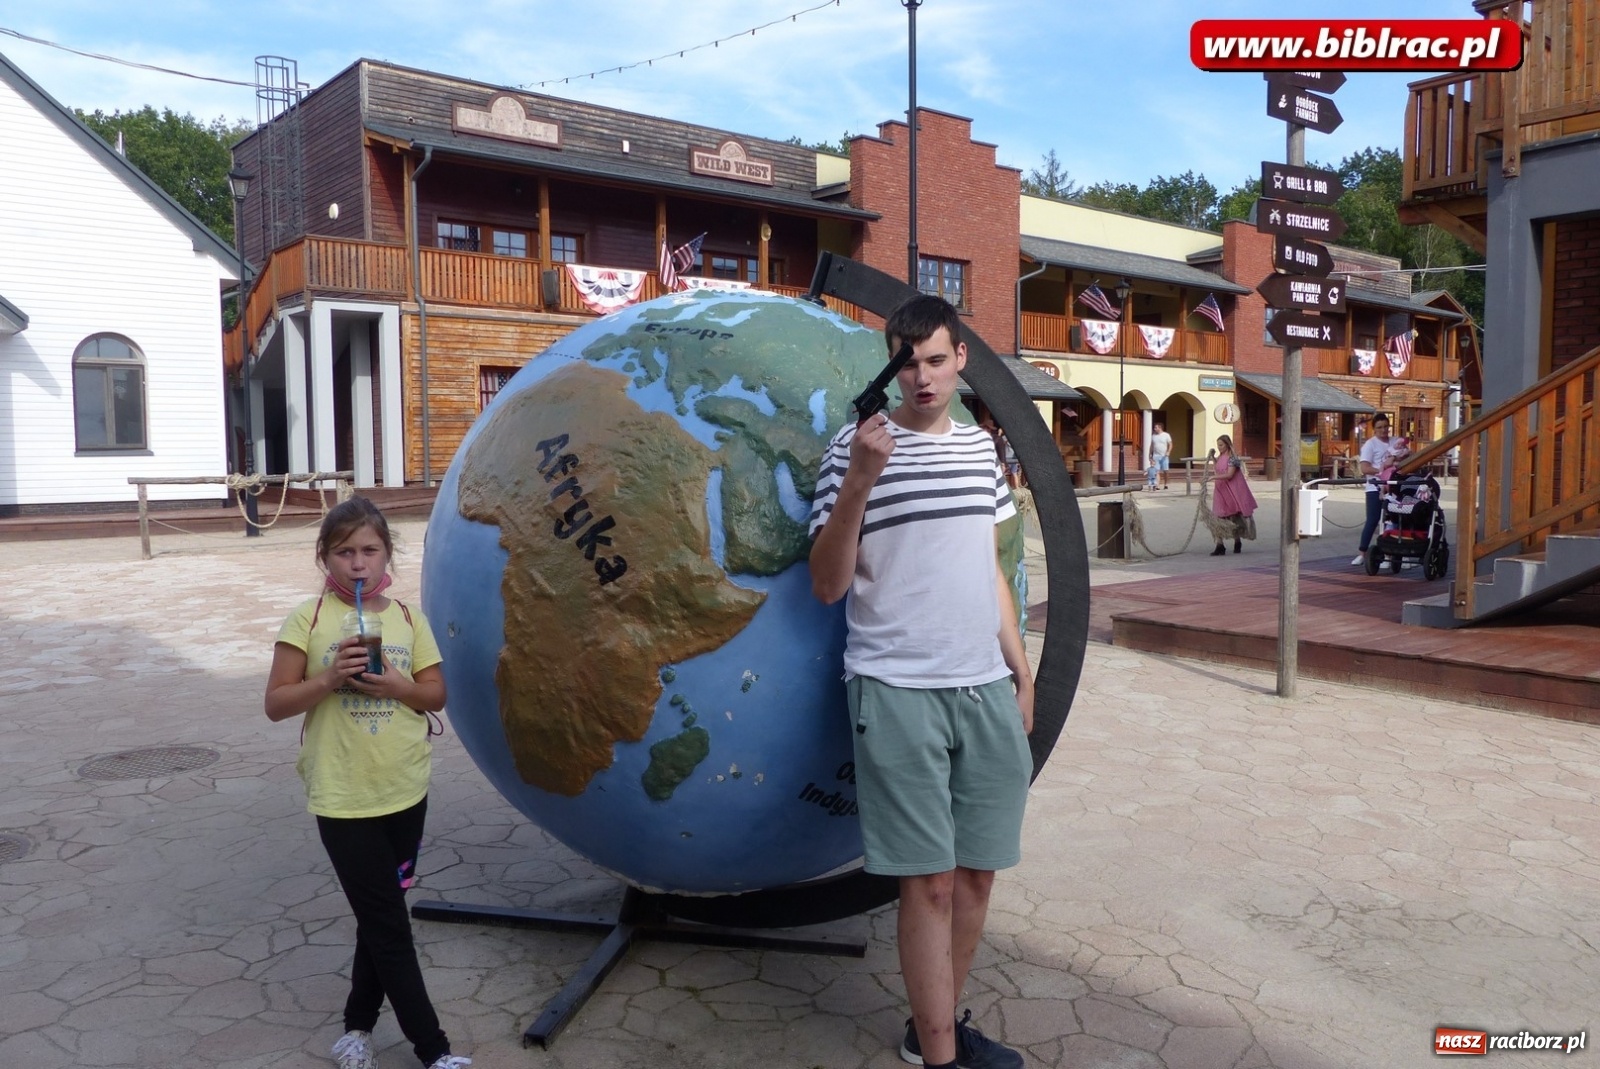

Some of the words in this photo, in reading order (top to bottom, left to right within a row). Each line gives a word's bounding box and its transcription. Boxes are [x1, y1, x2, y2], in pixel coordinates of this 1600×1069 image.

[1295, 96, 1319, 112] OGRÓDEK
[1295, 107, 1319, 123] FARMERA
[696, 155, 731, 172] WILD
[734, 161, 769, 179] WEST
[1286, 176, 1305, 191] GRILL
[1306, 179, 1312, 191] &
[1314, 180, 1328, 194] BBQ
[1286, 213, 1330, 231] STRZELNICE
[1295, 249, 1305, 262] OLD
[1305, 253, 1318, 267] FOTO
[1290, 281, 1321, 294] KAWIARNIA
[1292, 292, 1304, 303] PAN
[1305, 294, 1319, 304] CAKE
[1286, 324, 1319, 339] RESTAURACJE
[798, 782, 859, 817] Indyjs
